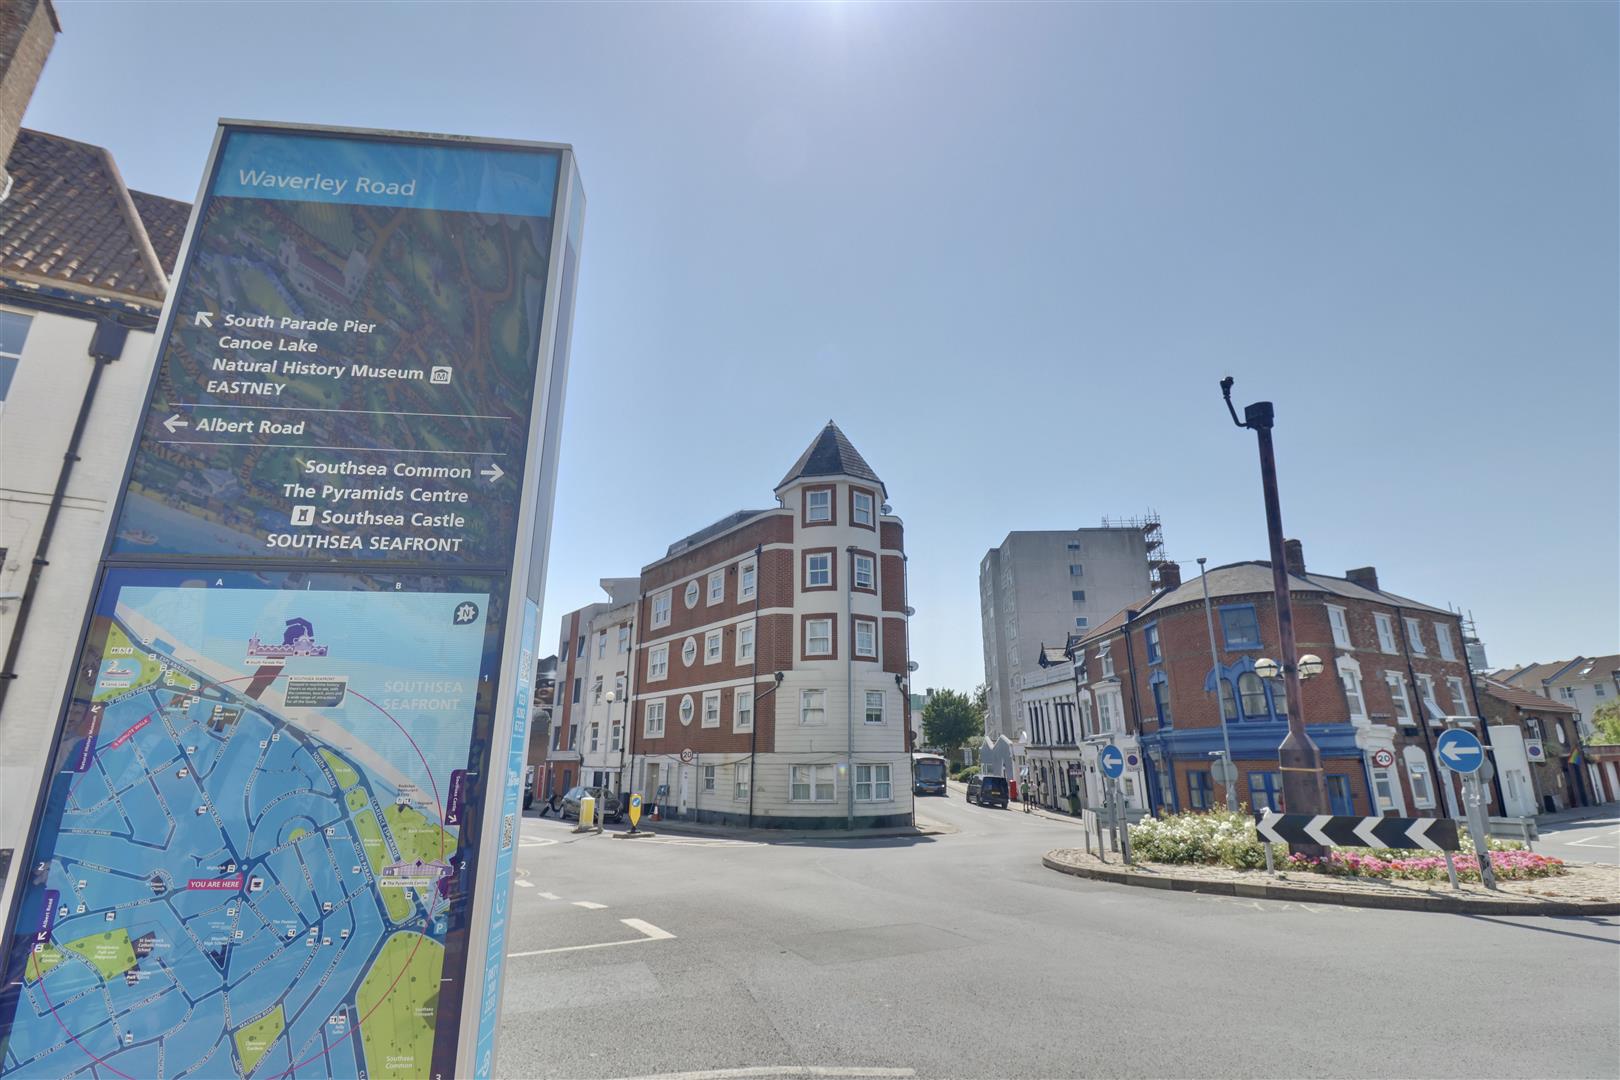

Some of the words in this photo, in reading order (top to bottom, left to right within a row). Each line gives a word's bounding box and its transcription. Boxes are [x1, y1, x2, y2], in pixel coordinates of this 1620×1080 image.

[238, 168, 347, 197] Waverley
[355, 176, 417, 197] Road
[224, 313, 276, 330] South
[281, 316, 338, 332] Parade
[343, 319, 376, 334] Pier
[218, 335, 274, 351] Canoe
[278, 338, 318, 353] Lake
[212, 357, 278, 374] Natural
[283, 360, 345, 380] History
[350, 364, 424, 380] Museum
[206, 380, 287, 396] EASTNEY
[195, 418, 254, 435] Albert
[259, 420, 305, 435] Road
[305, 460, 388, 477] Southsea
[393, 462, 472, 479] Common
[283, 483, 317, 499] The
[321, 485, 405, 503] Pyramids
[410, 488, 468, 503] Centre
[320, 510, 405, 527] Southsea
[410, 512, 465, 529] Castle
[266, 533, 363, 551] SOUTHSEA
[369, 536, 462, 553] SEAFRONT
[216, 578, 224, 586] A
[462, 608, 470, 618] N
[159, 654, 188, 674] ESPLANADE
[384, 681, 464, 694] SOUTHSEA
[382, 698, 460, 711] SEAFRONT
[87, 714, 97, 735] Museum
[82, 735, 92, 751] History
[79, 751, 88, 770] Natural
[311, 750, 325, 769] SOUTH
[322, 767, 337, 788] PARADE
[370, 798, 386, 826] CLARENCE
[382, 826, 400, 857] ESPLANADE
[38, 862, 46, 871] 2
[352, 841, 365, 860] SOUTH
[360, 861, 374, 884] PARADE
[460, 861, 466, 870] 2
[42, 910, 50, 928] Albert
[238, 1012, 261, 1029] MALVERN
